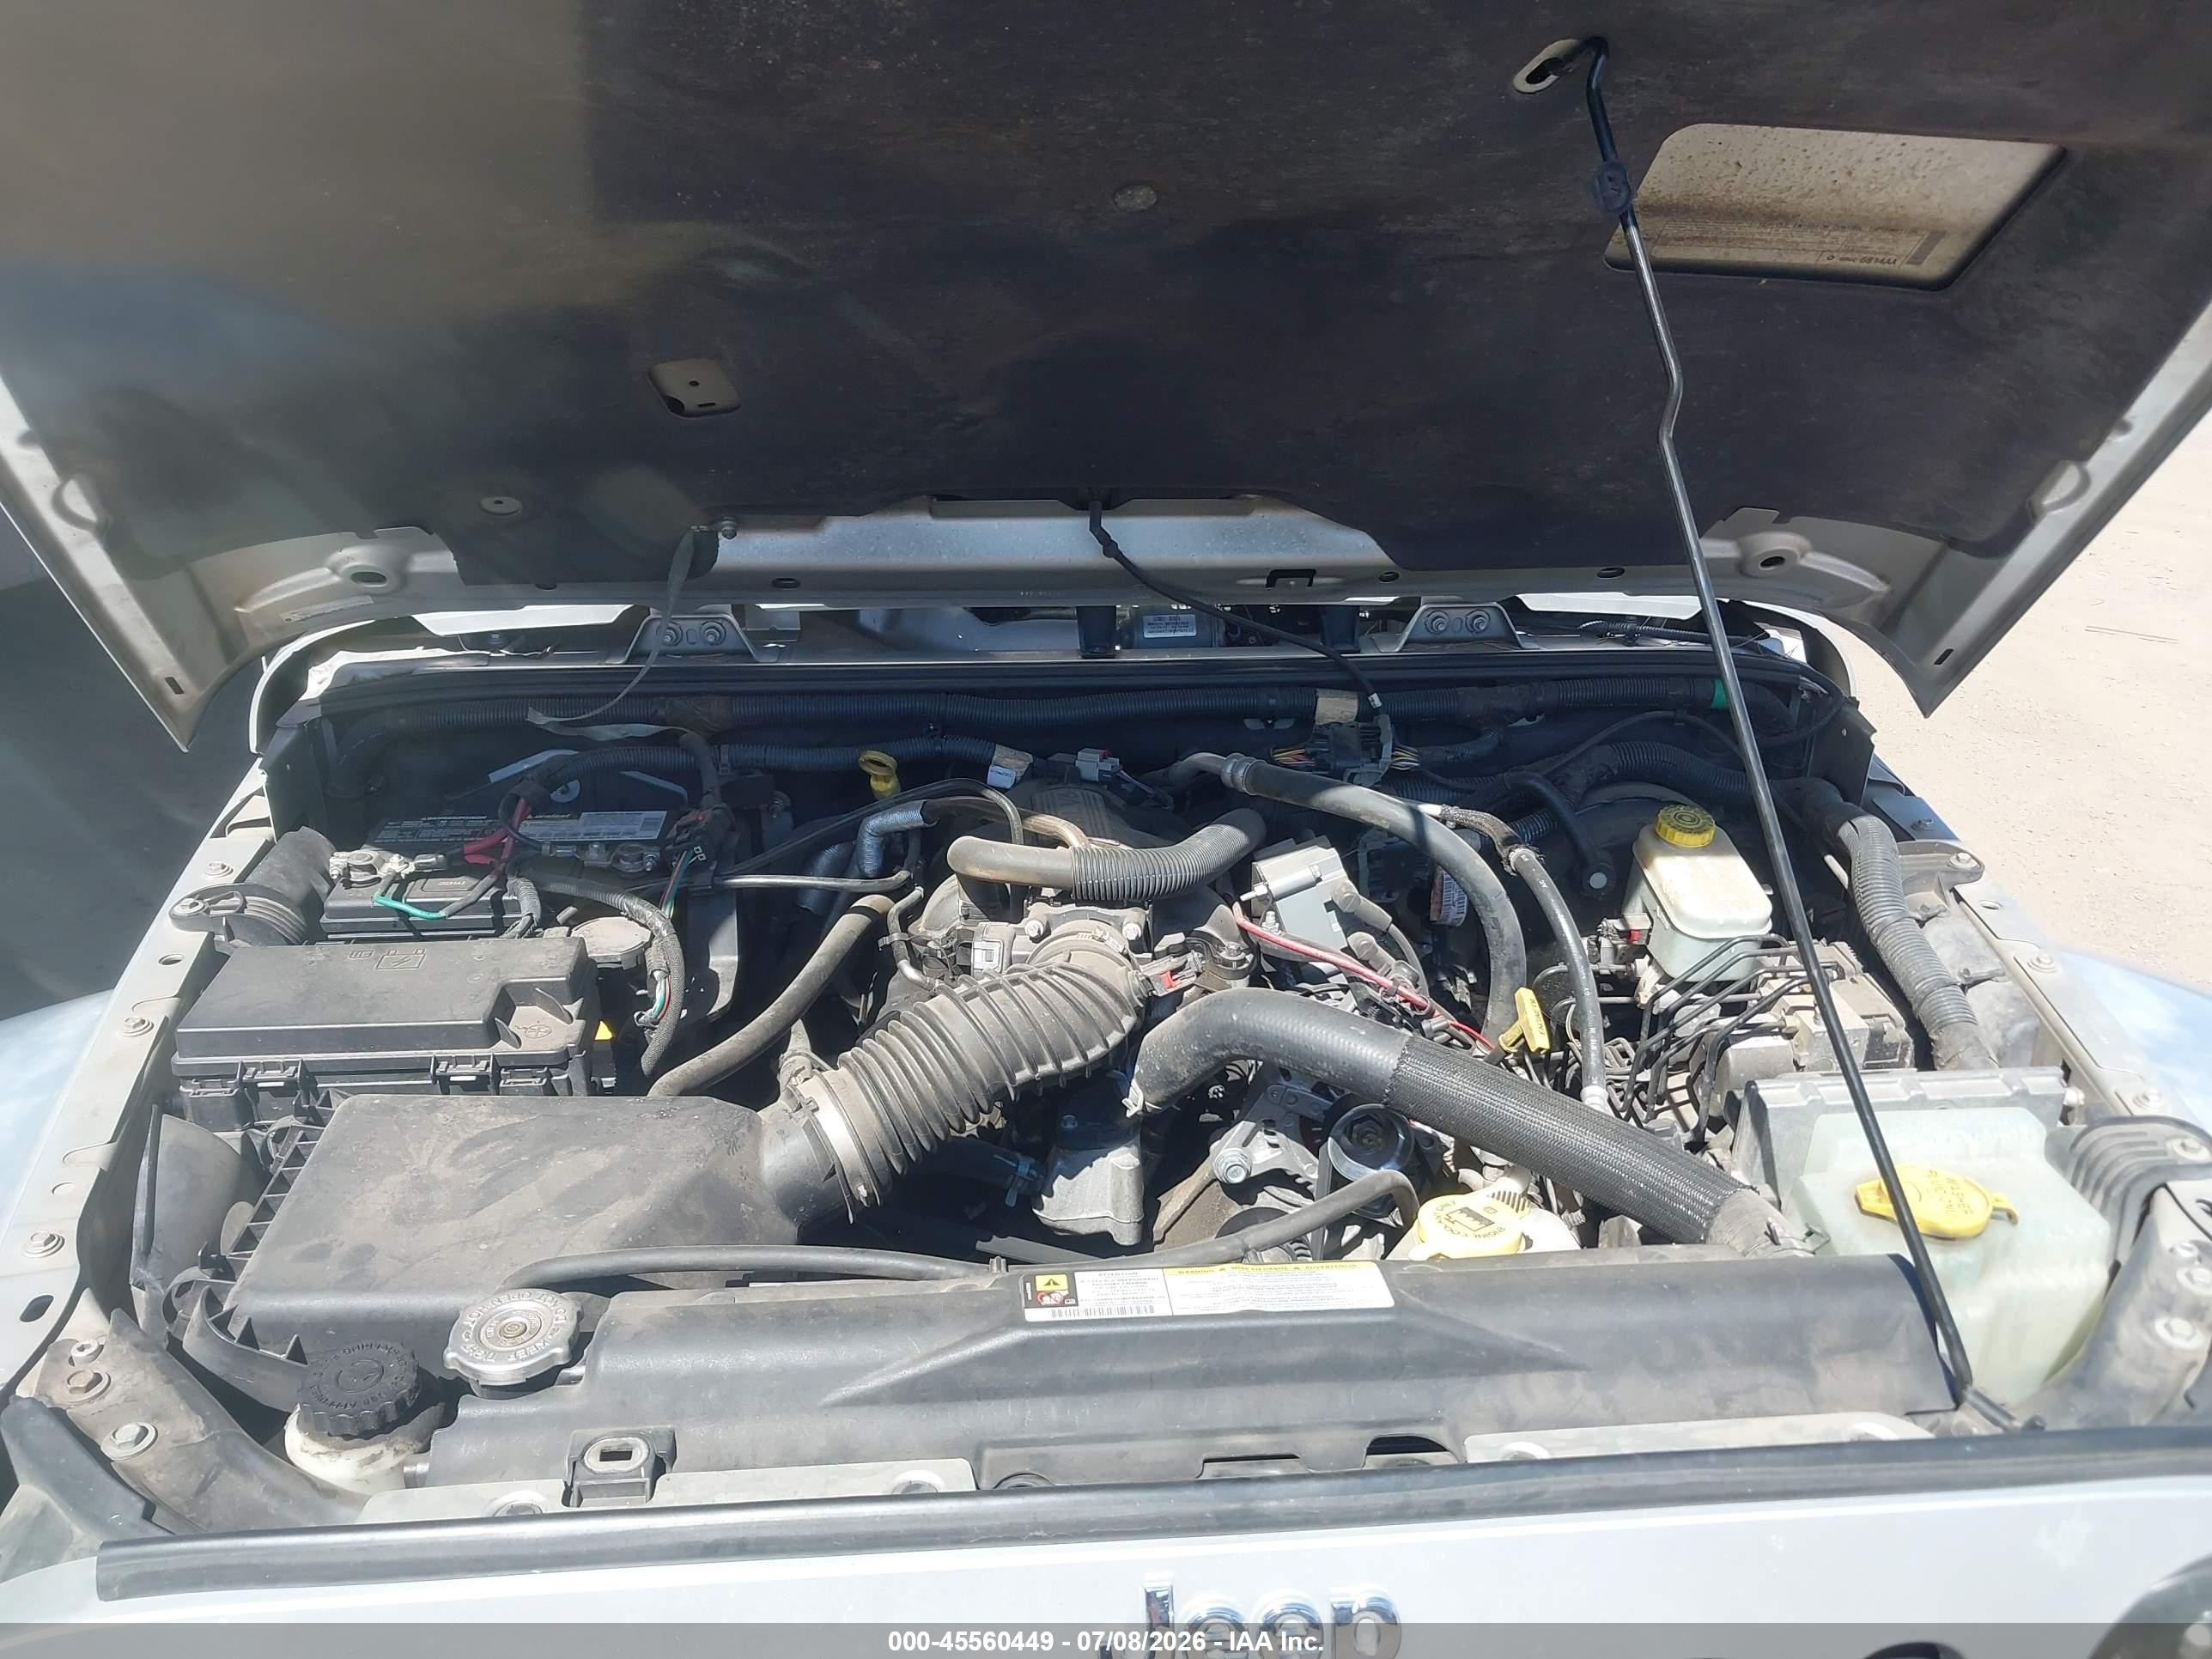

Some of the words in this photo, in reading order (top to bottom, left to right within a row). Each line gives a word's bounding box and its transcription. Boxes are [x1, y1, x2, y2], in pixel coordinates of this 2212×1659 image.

[490, 1291, 532, 1308] OPEN
[462, 1304, 489, 1328] HOT
[1101, 1574, 1401, 1659] Jeep
